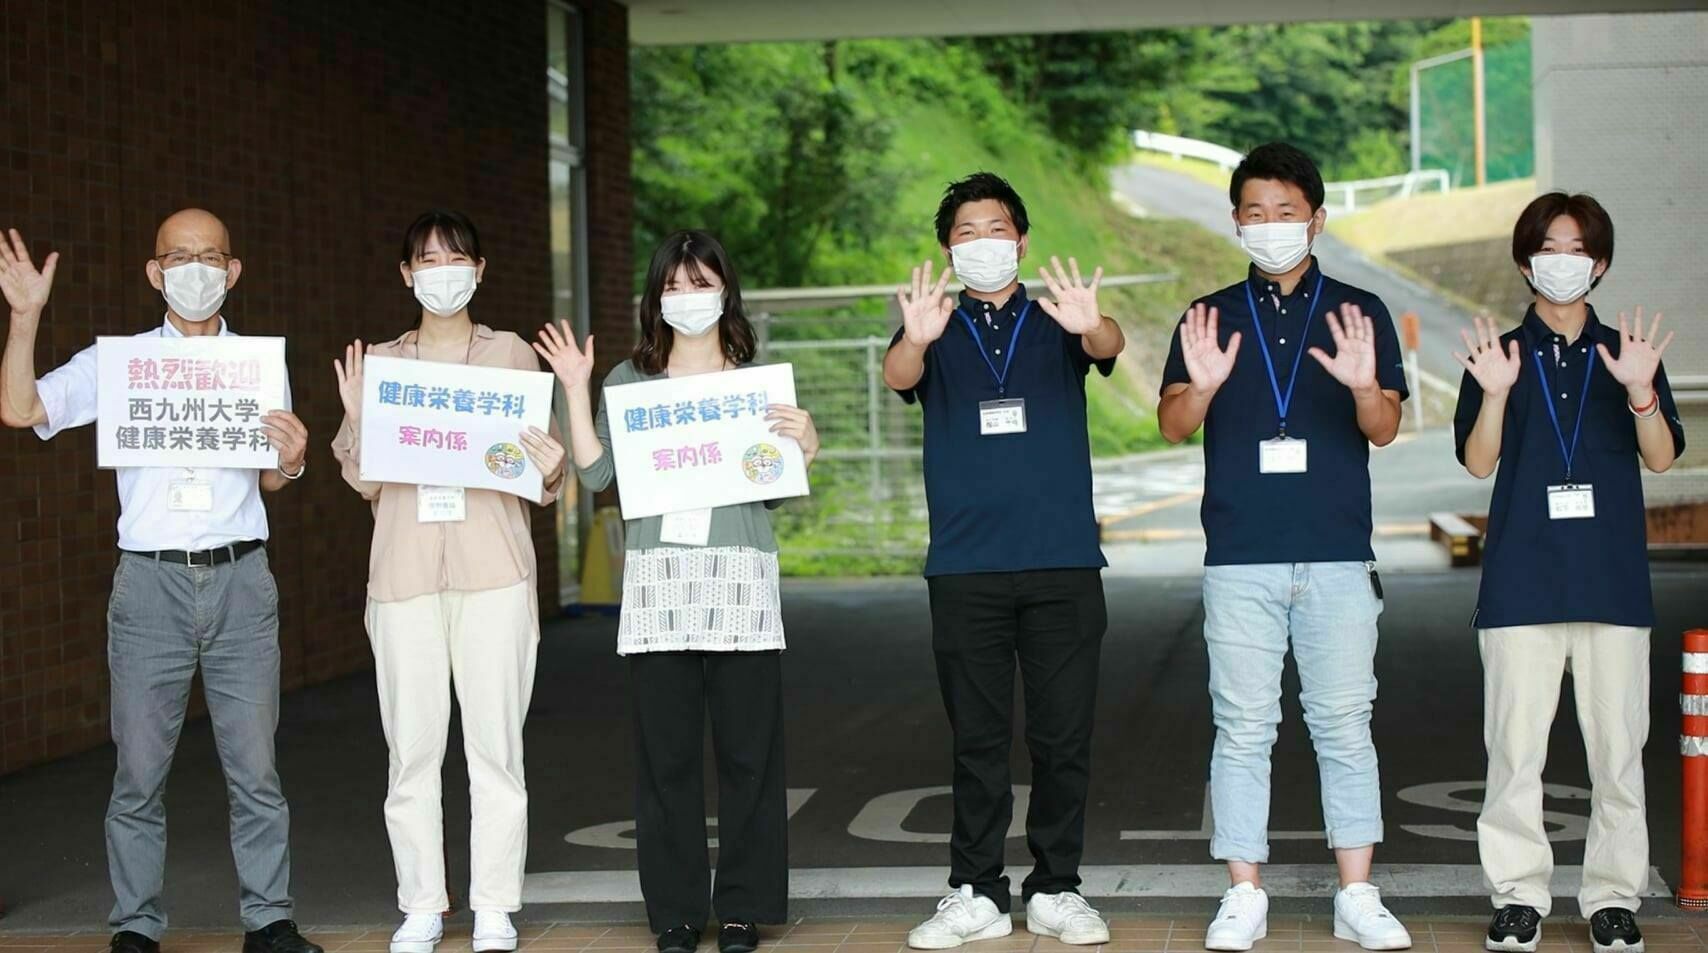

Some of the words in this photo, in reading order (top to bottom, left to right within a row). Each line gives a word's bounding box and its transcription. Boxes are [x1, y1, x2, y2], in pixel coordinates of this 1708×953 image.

[128, 397, 260, 423] 西九州大学
[378, 380, 526, 419] 健康栄養学科
[624, 390, 769, 433] 健康栄養学科
[115, 425, 271, 452] 健康栄養学科
[398, 425, 468, 451] 案内係
[652, 441, 723, 471] 案内係
